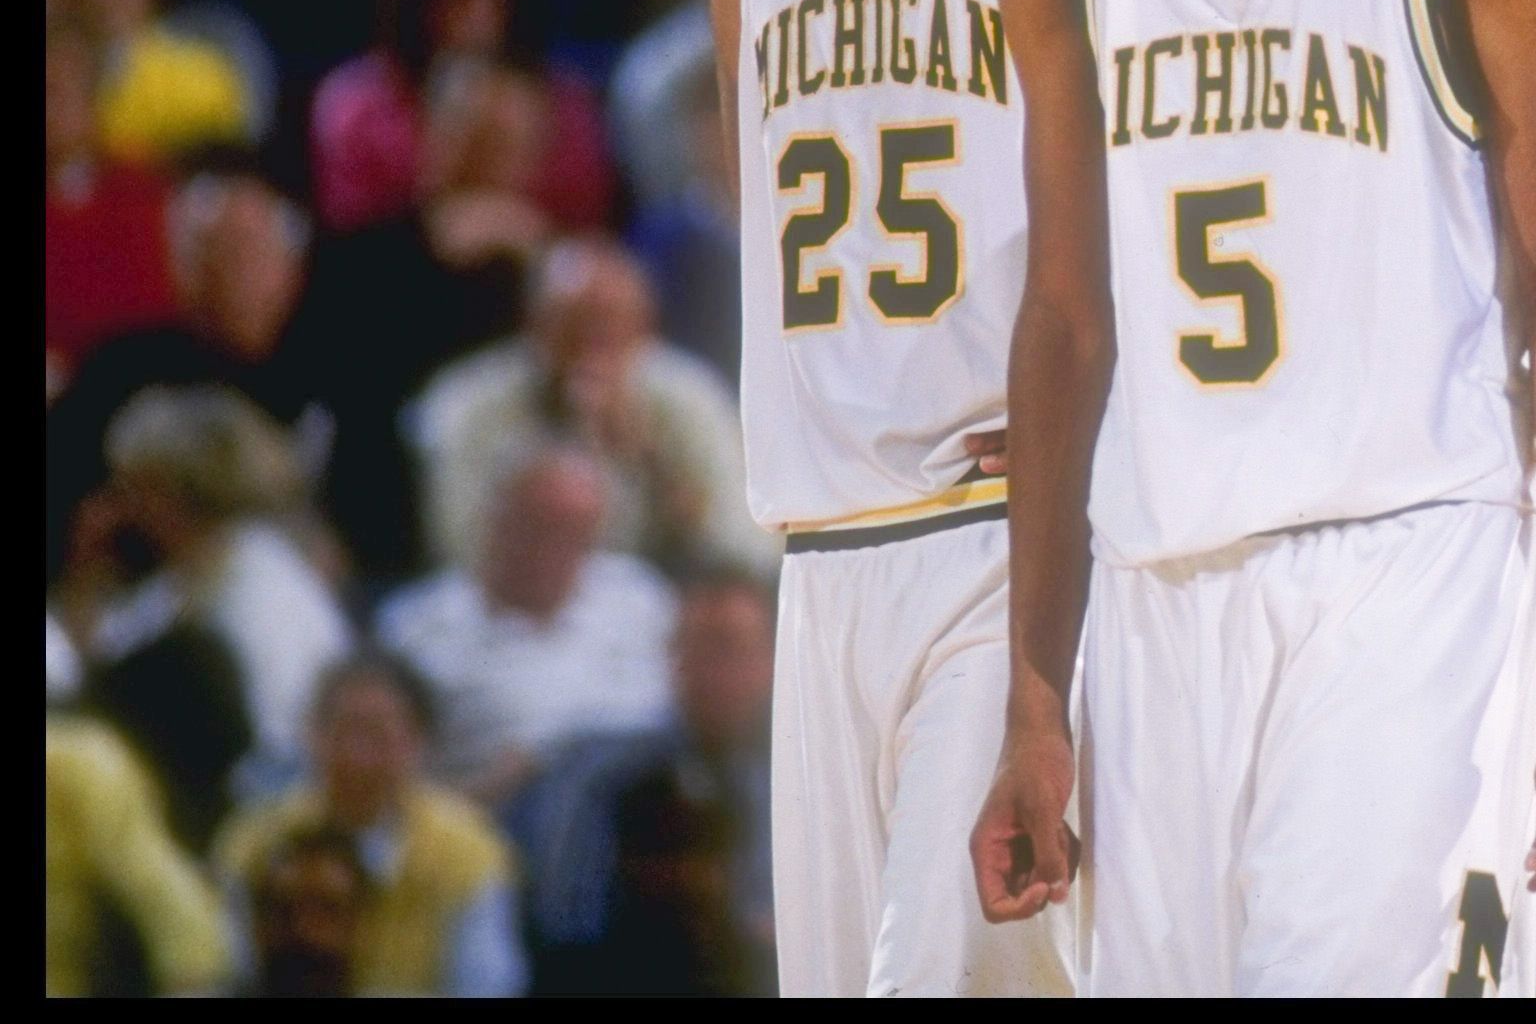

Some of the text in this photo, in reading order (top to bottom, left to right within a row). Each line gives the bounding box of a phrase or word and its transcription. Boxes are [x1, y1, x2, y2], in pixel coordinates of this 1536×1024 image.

[1106, 27, 1391, 154] ICHIGAN
[776, 119, 964, 338] 25
[1172, 175, 1286, 389] 5
